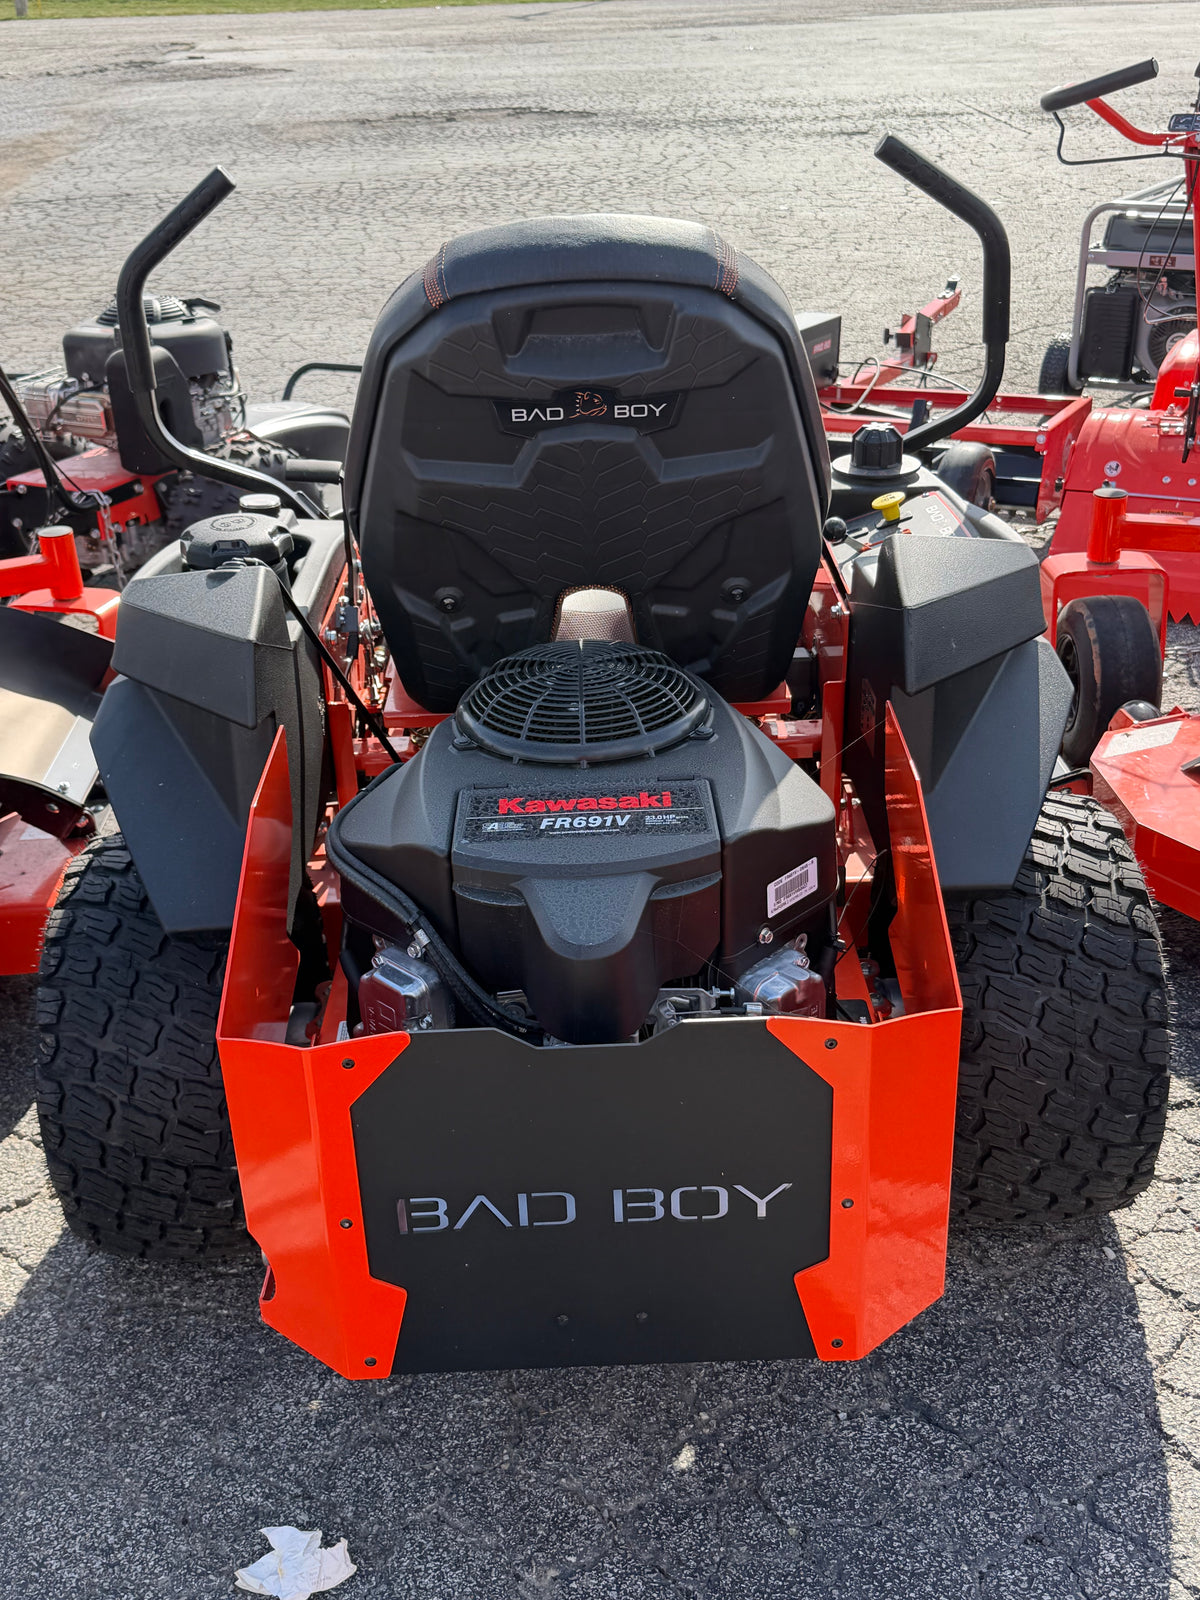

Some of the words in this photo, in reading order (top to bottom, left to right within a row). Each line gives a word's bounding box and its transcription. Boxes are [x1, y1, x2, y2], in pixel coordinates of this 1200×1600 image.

[511, 407, 564, 422] BAD
[614, 403, 667, 418] BOY
[498, 791, 672, 815] Kawasaki
[539, 814, 632, 830] FR691V
[397, 1191, 577, 1235] BAD
[613, 1183, 793, 1224] BOY
